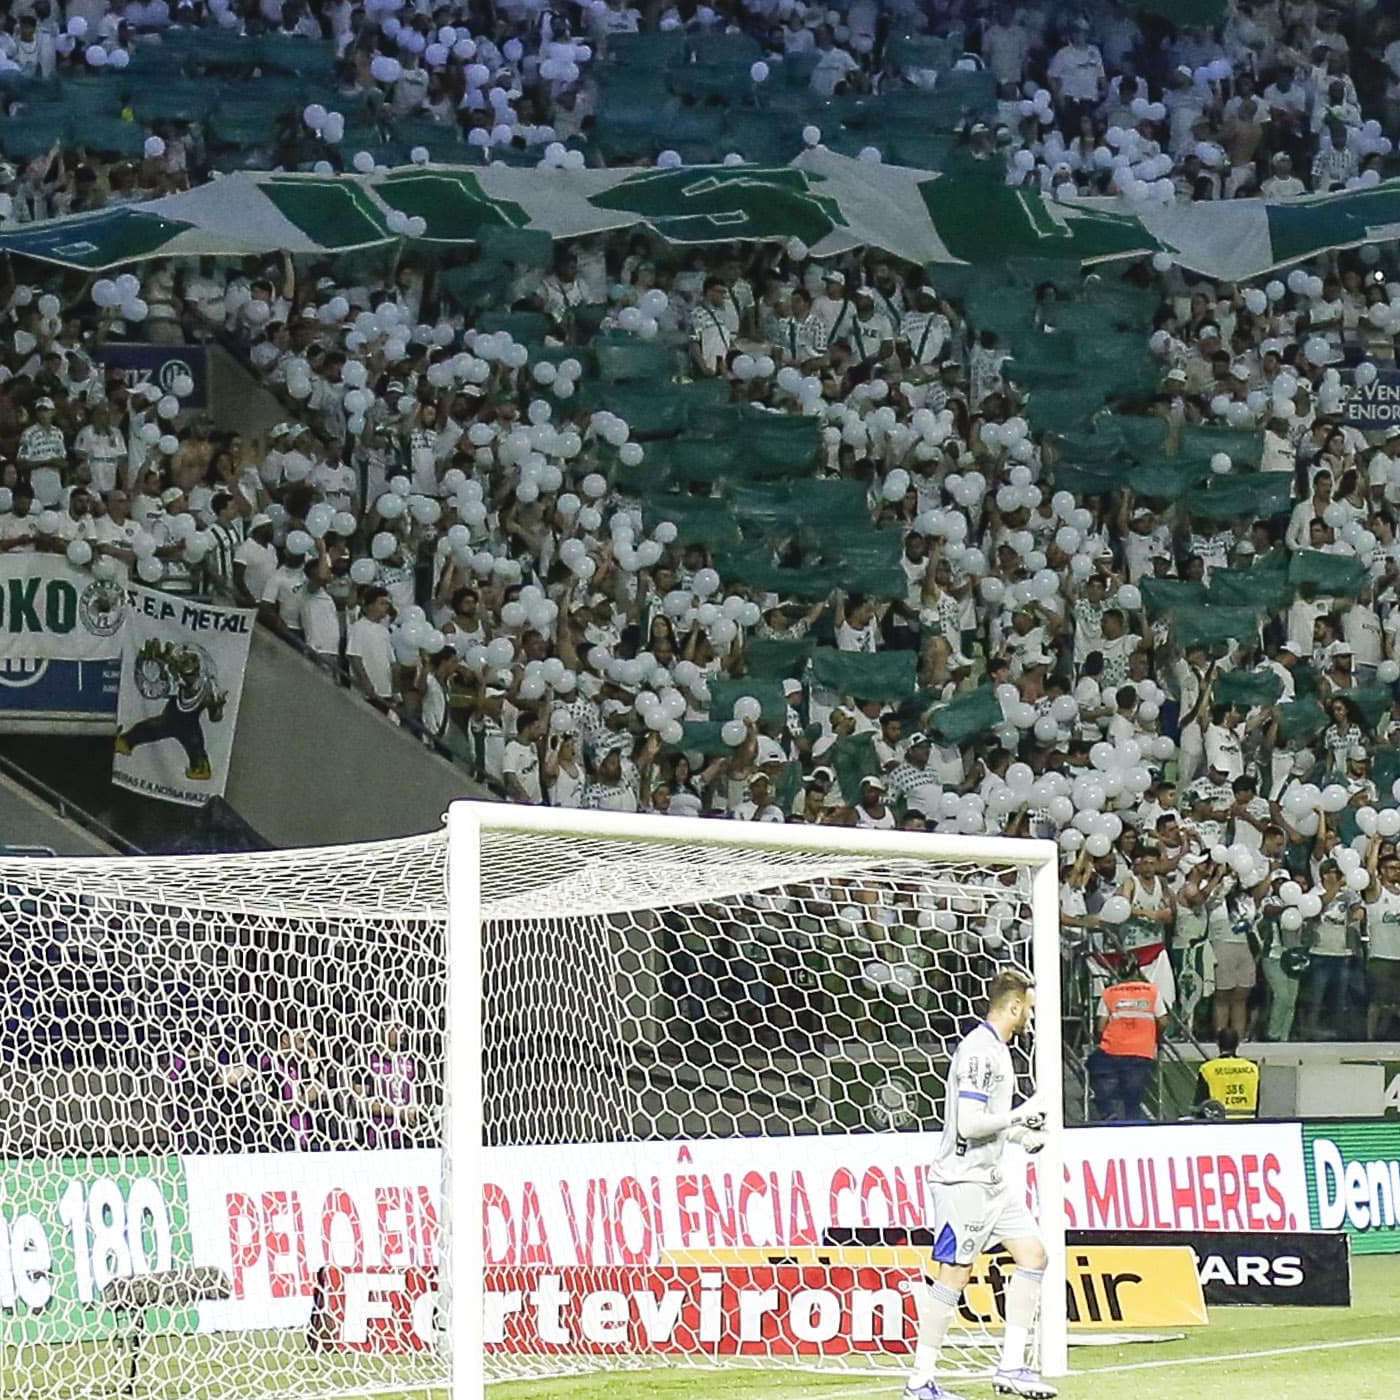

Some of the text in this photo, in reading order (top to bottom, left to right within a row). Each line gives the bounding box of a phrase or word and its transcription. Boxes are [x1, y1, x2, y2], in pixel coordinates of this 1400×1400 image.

[181, 606, 250, 634] METAL
[1083, 1152, 1298, 1231] MULHERES.
[226, 1185, 363, 1301] PELO
[481, 1181, 553, 1267] DA
[560, 1144, 818, 1268] VIOLÊNCIA
[1197, 1255, 1304, 1288] ARS
